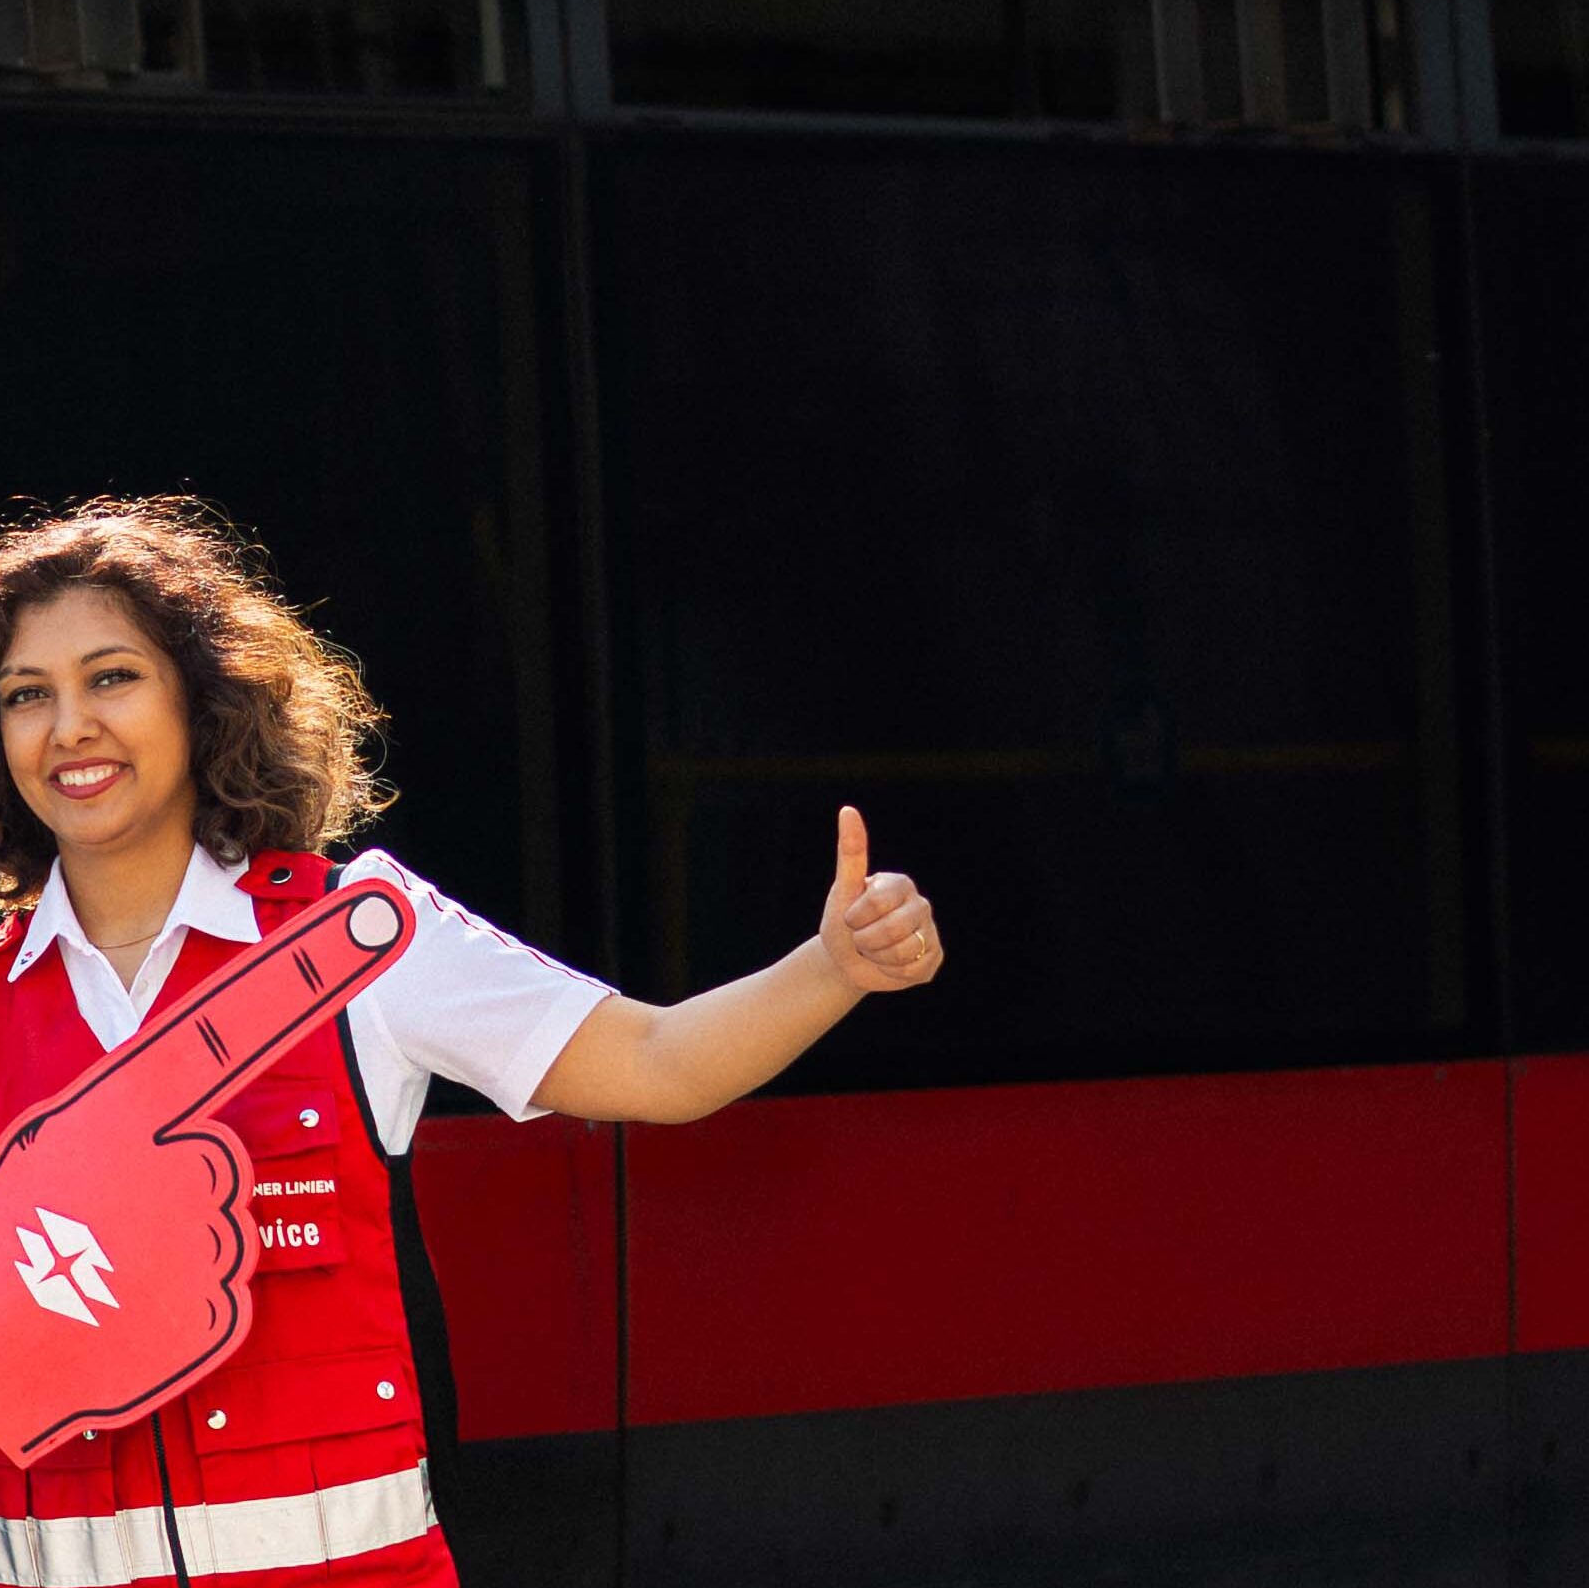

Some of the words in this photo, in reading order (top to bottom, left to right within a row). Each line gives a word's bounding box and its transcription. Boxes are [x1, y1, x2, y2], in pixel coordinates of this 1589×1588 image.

[252, 1182, 283, 1197] NER
[285, 1180, 335, 1195] LINIEN
[259, 1217, 320, 1249] vice
